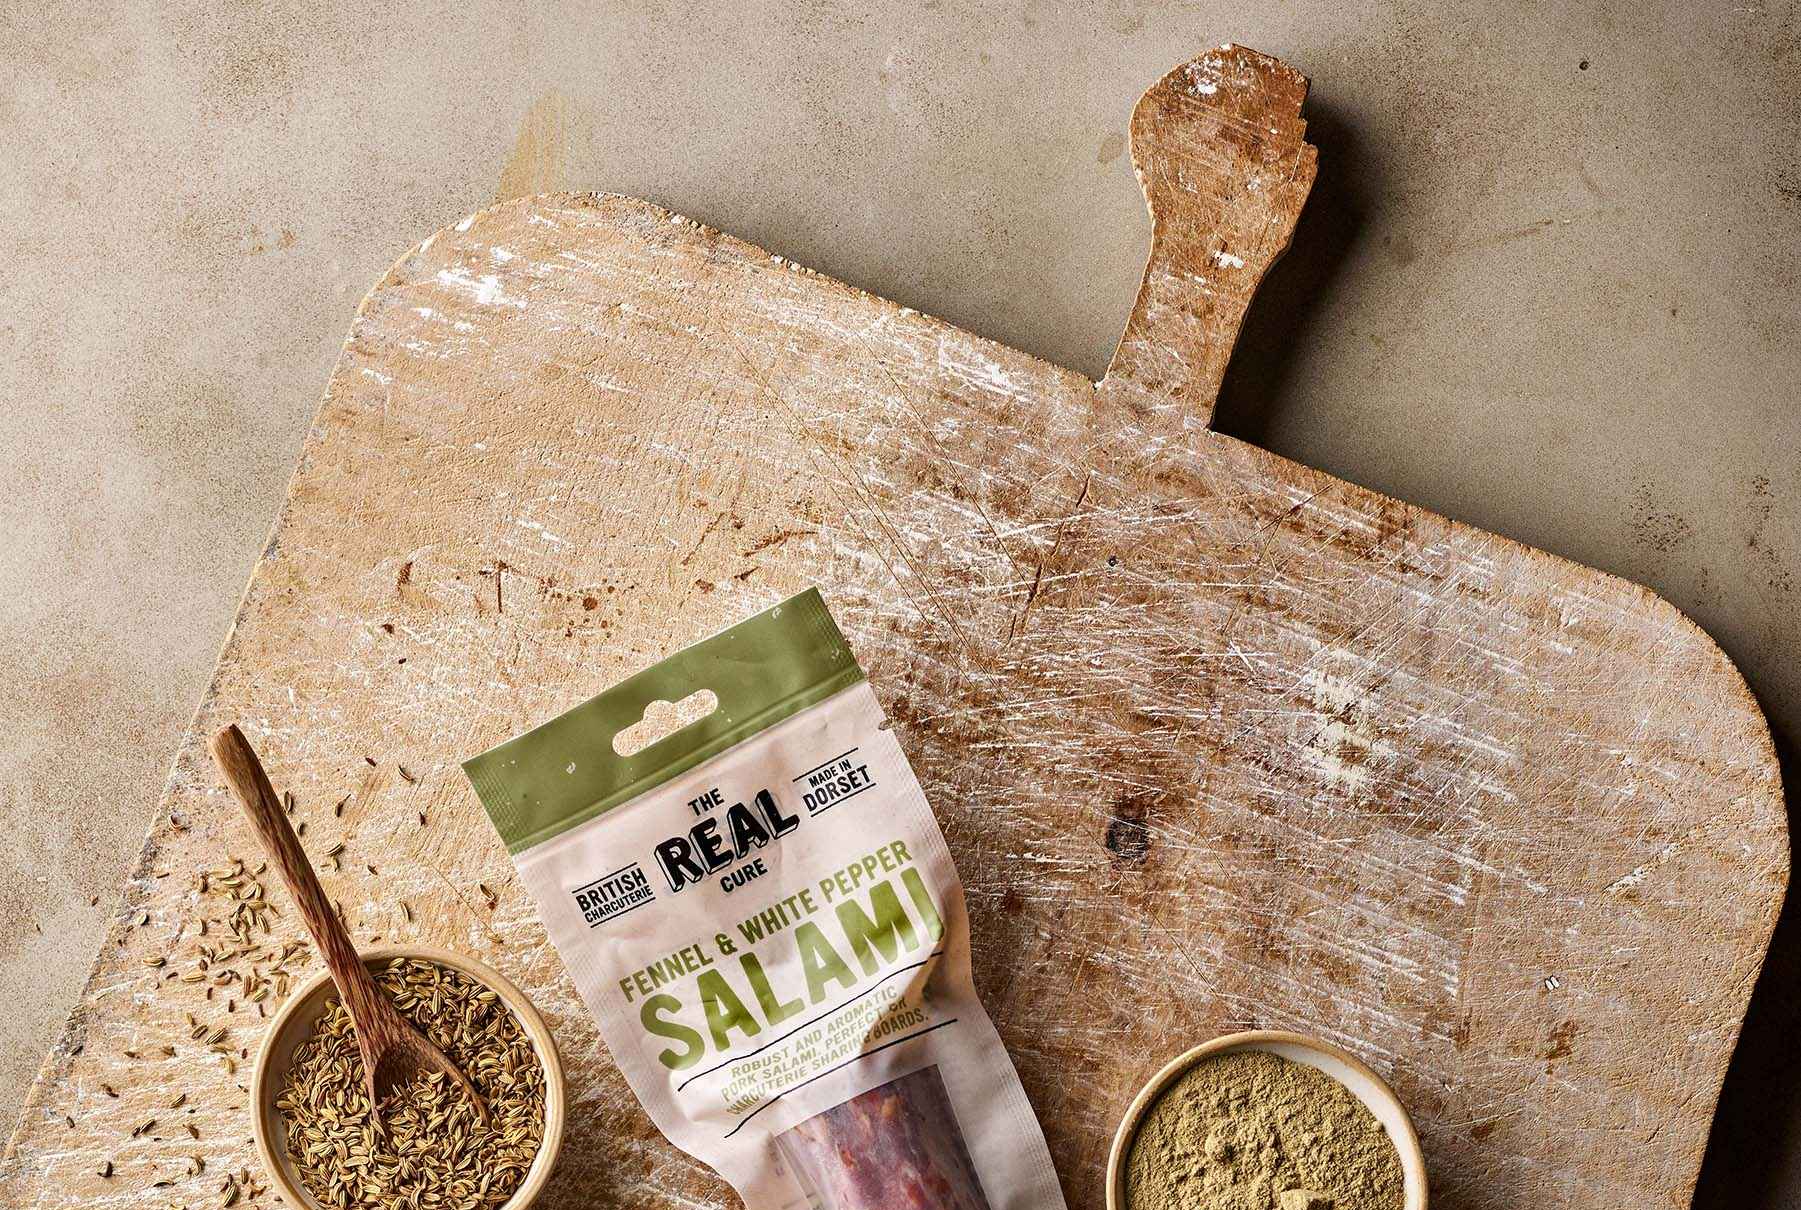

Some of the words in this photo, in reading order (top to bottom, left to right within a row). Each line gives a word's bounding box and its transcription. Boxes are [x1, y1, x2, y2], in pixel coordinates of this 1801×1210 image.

[802, 765, 872, 812] DORSET
[808, 767, 839, 789] MADE
[838, 759, 852, 772] IN
[687, 788, 725, 816] THE
[654, 789, 800, 893] REAL
[575, 868, 647, 913] BRITISH
[720, 858, 768, 893] CURE
[584, 885, 654, 923] CHARCUTERIE
[619, 943, 713, 1003] FENNEL
[714, 933, 738, 956] &
[737, 889, 818, 944] WHITE
[818, 840, 913, 903] PEPPER
[640, 867, 944, 1071] SALAMI
[721, 1073, 757, 1102] PORK
[825, 1007, 883, 1047] PERFECT
[731, 1045, 790, 1078] ROBUST
[795, 1029, 824, 1053] AND
[827, 985, 897, 1034] AROMATIC
